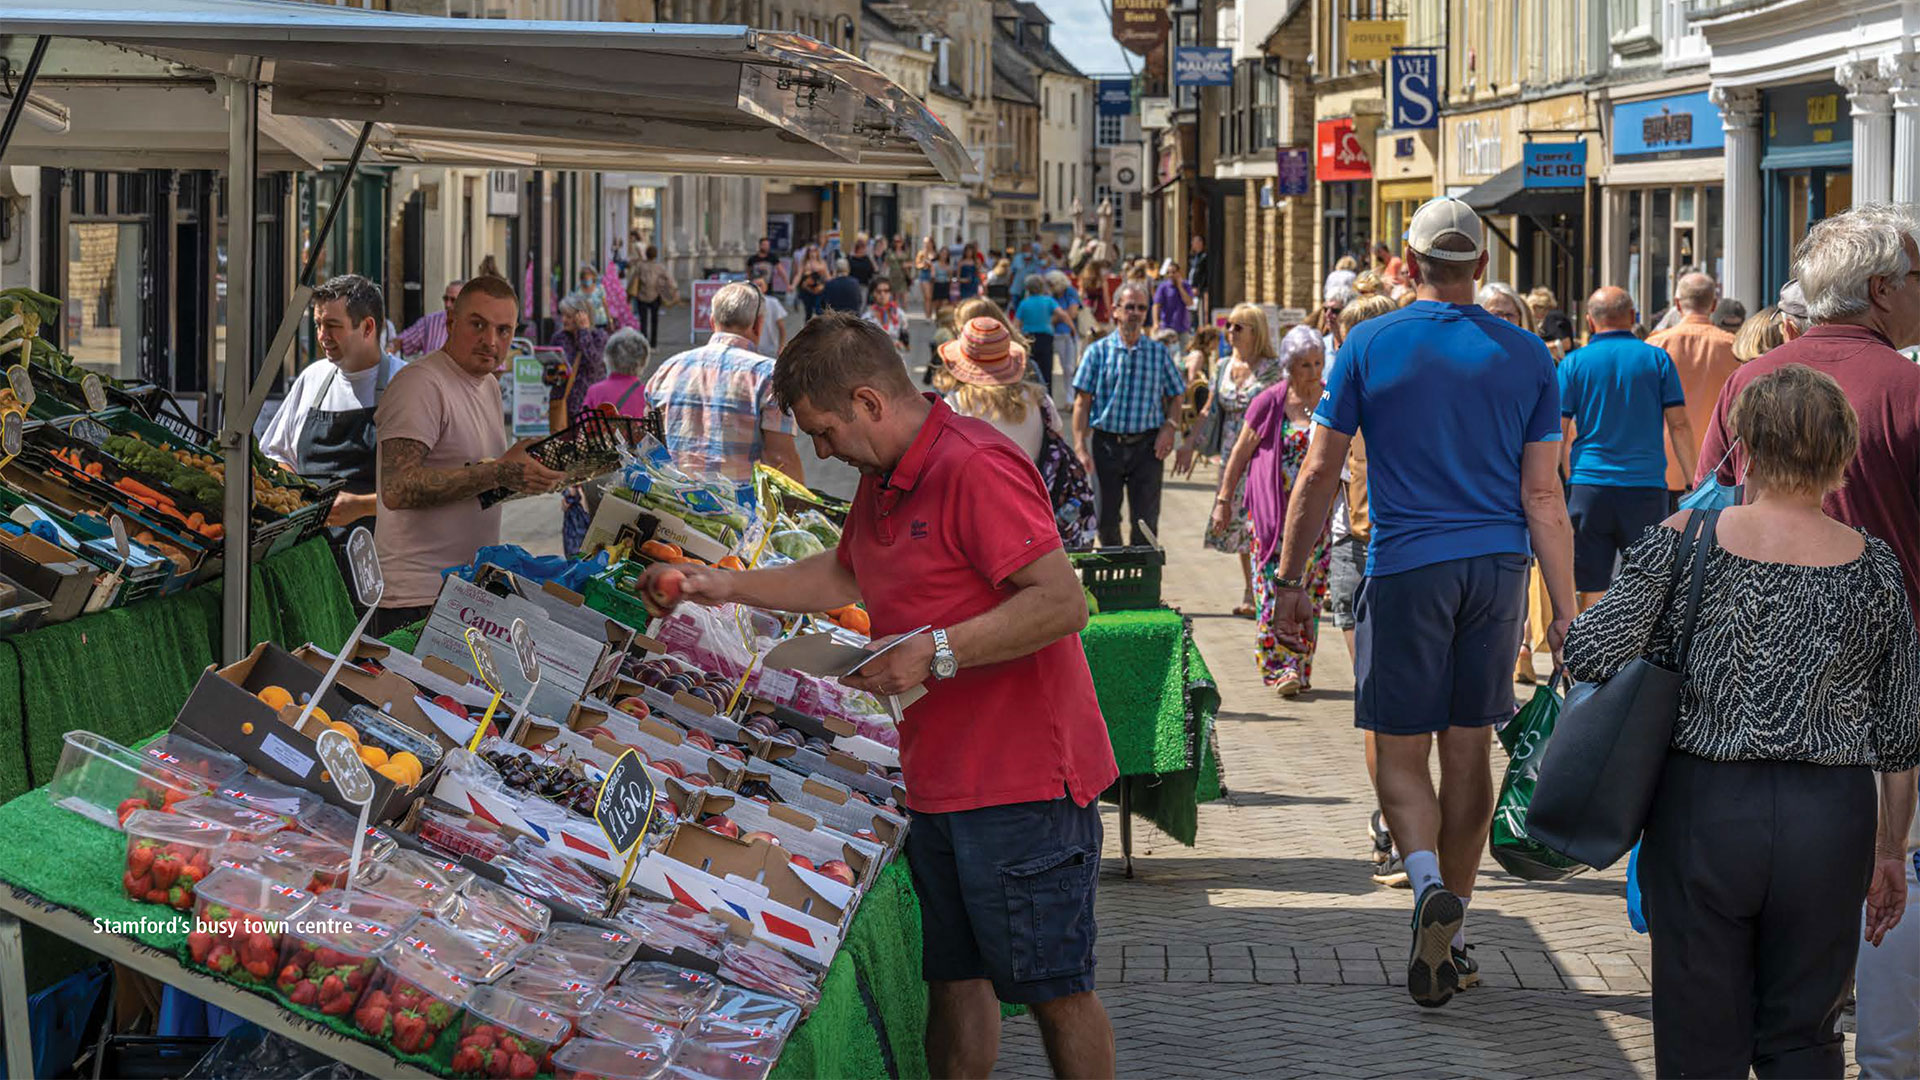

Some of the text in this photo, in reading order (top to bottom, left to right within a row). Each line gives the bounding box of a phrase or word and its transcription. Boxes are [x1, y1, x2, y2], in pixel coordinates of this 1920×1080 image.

[1353, 33, 1400, 43] JOULES
[1177, 61, 1229, 72] HALIFAX
[1398, 58, 1429, 74] WH
[1399, 73, 1433, 125] S
[1526, 163, 1582, 177] NERO
